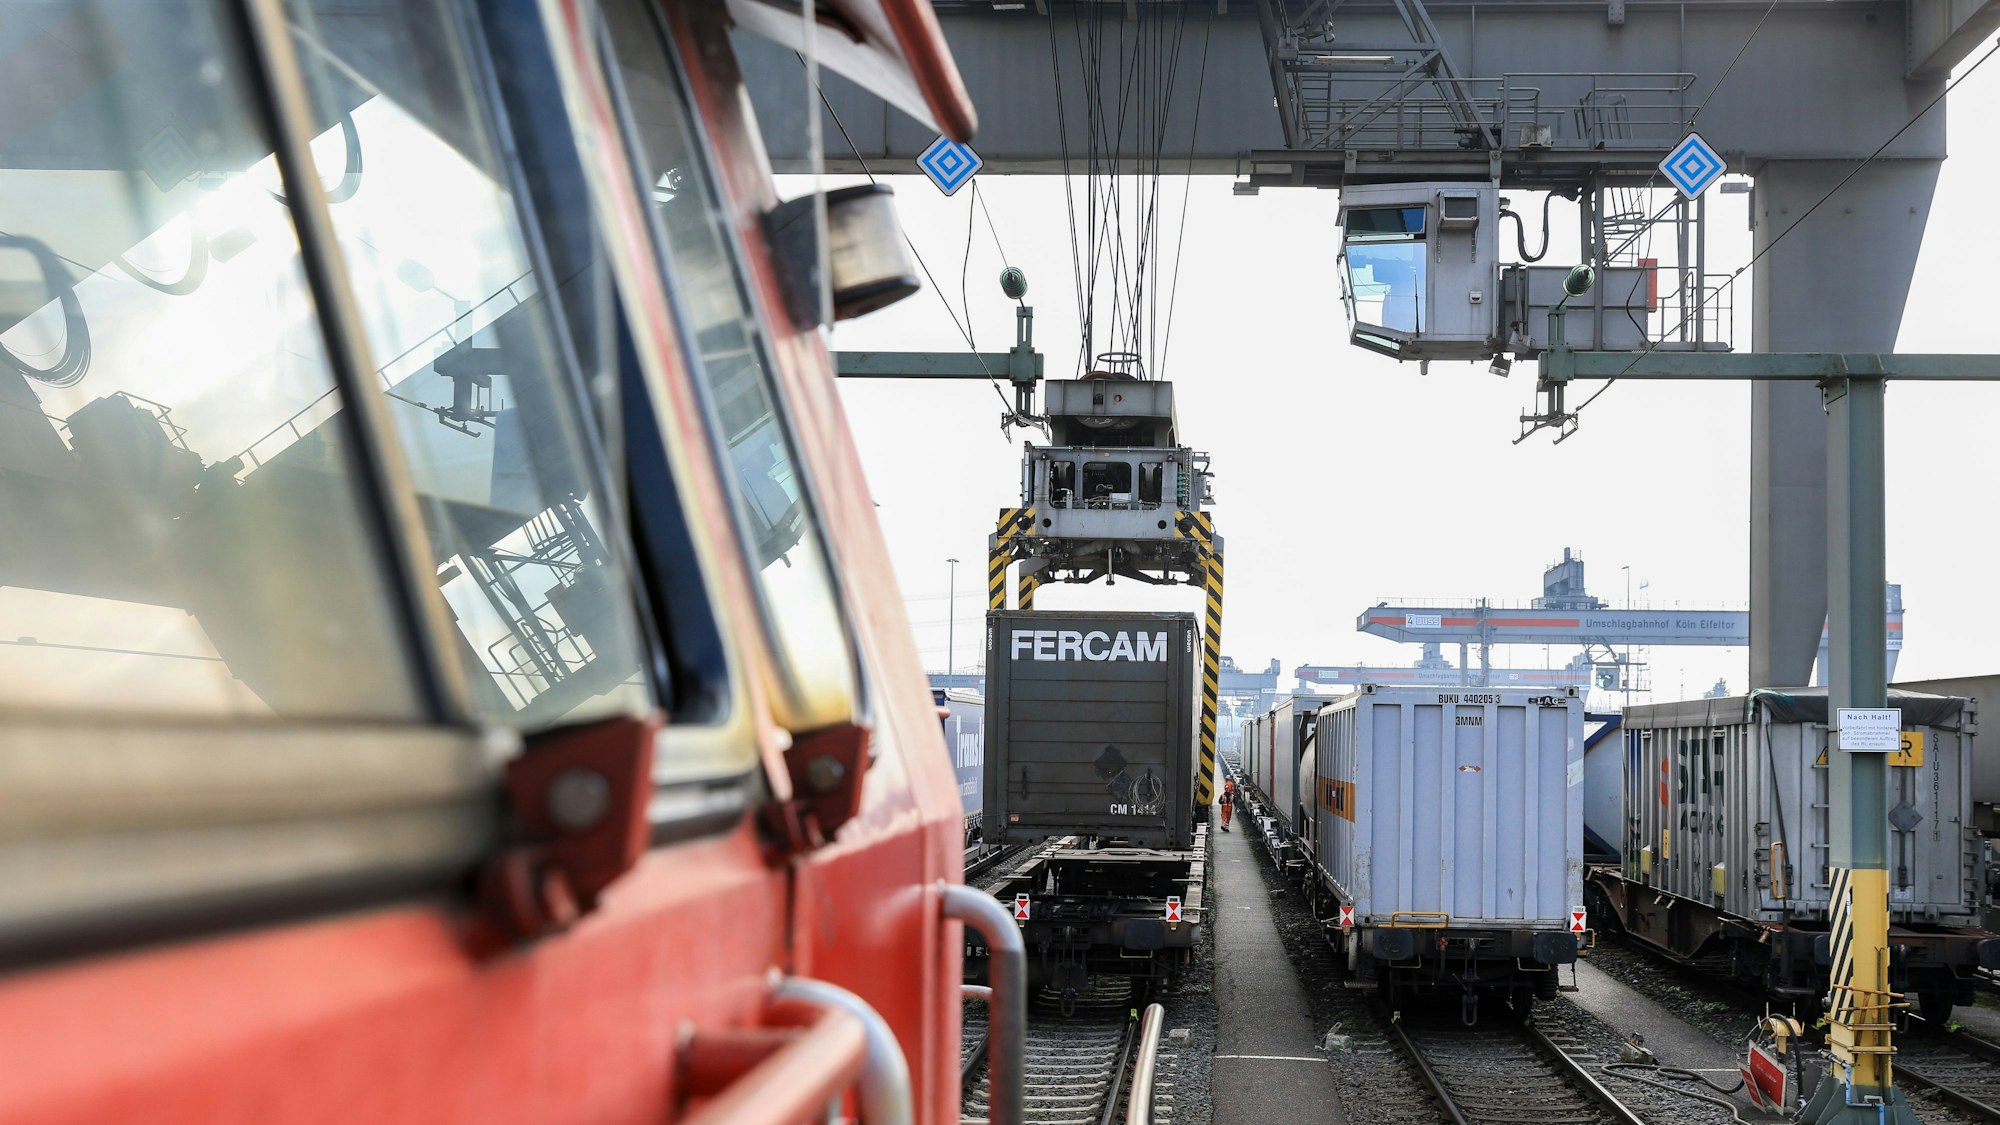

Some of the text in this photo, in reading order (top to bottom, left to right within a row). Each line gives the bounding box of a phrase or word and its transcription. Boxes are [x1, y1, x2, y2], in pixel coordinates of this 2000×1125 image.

[1585, 619, 1736, 630] Umschlagbahnhof Köln Eifeltor
[1011, 629, 1168, 662] FERCAM
[1438, 694, 1501, 704] BUKU 440205 3
[1537, 697, 1559, 705] LAG
[1455, 716, 1483, 726] 3MNM
[1110, 803, 1128, 815] CM
